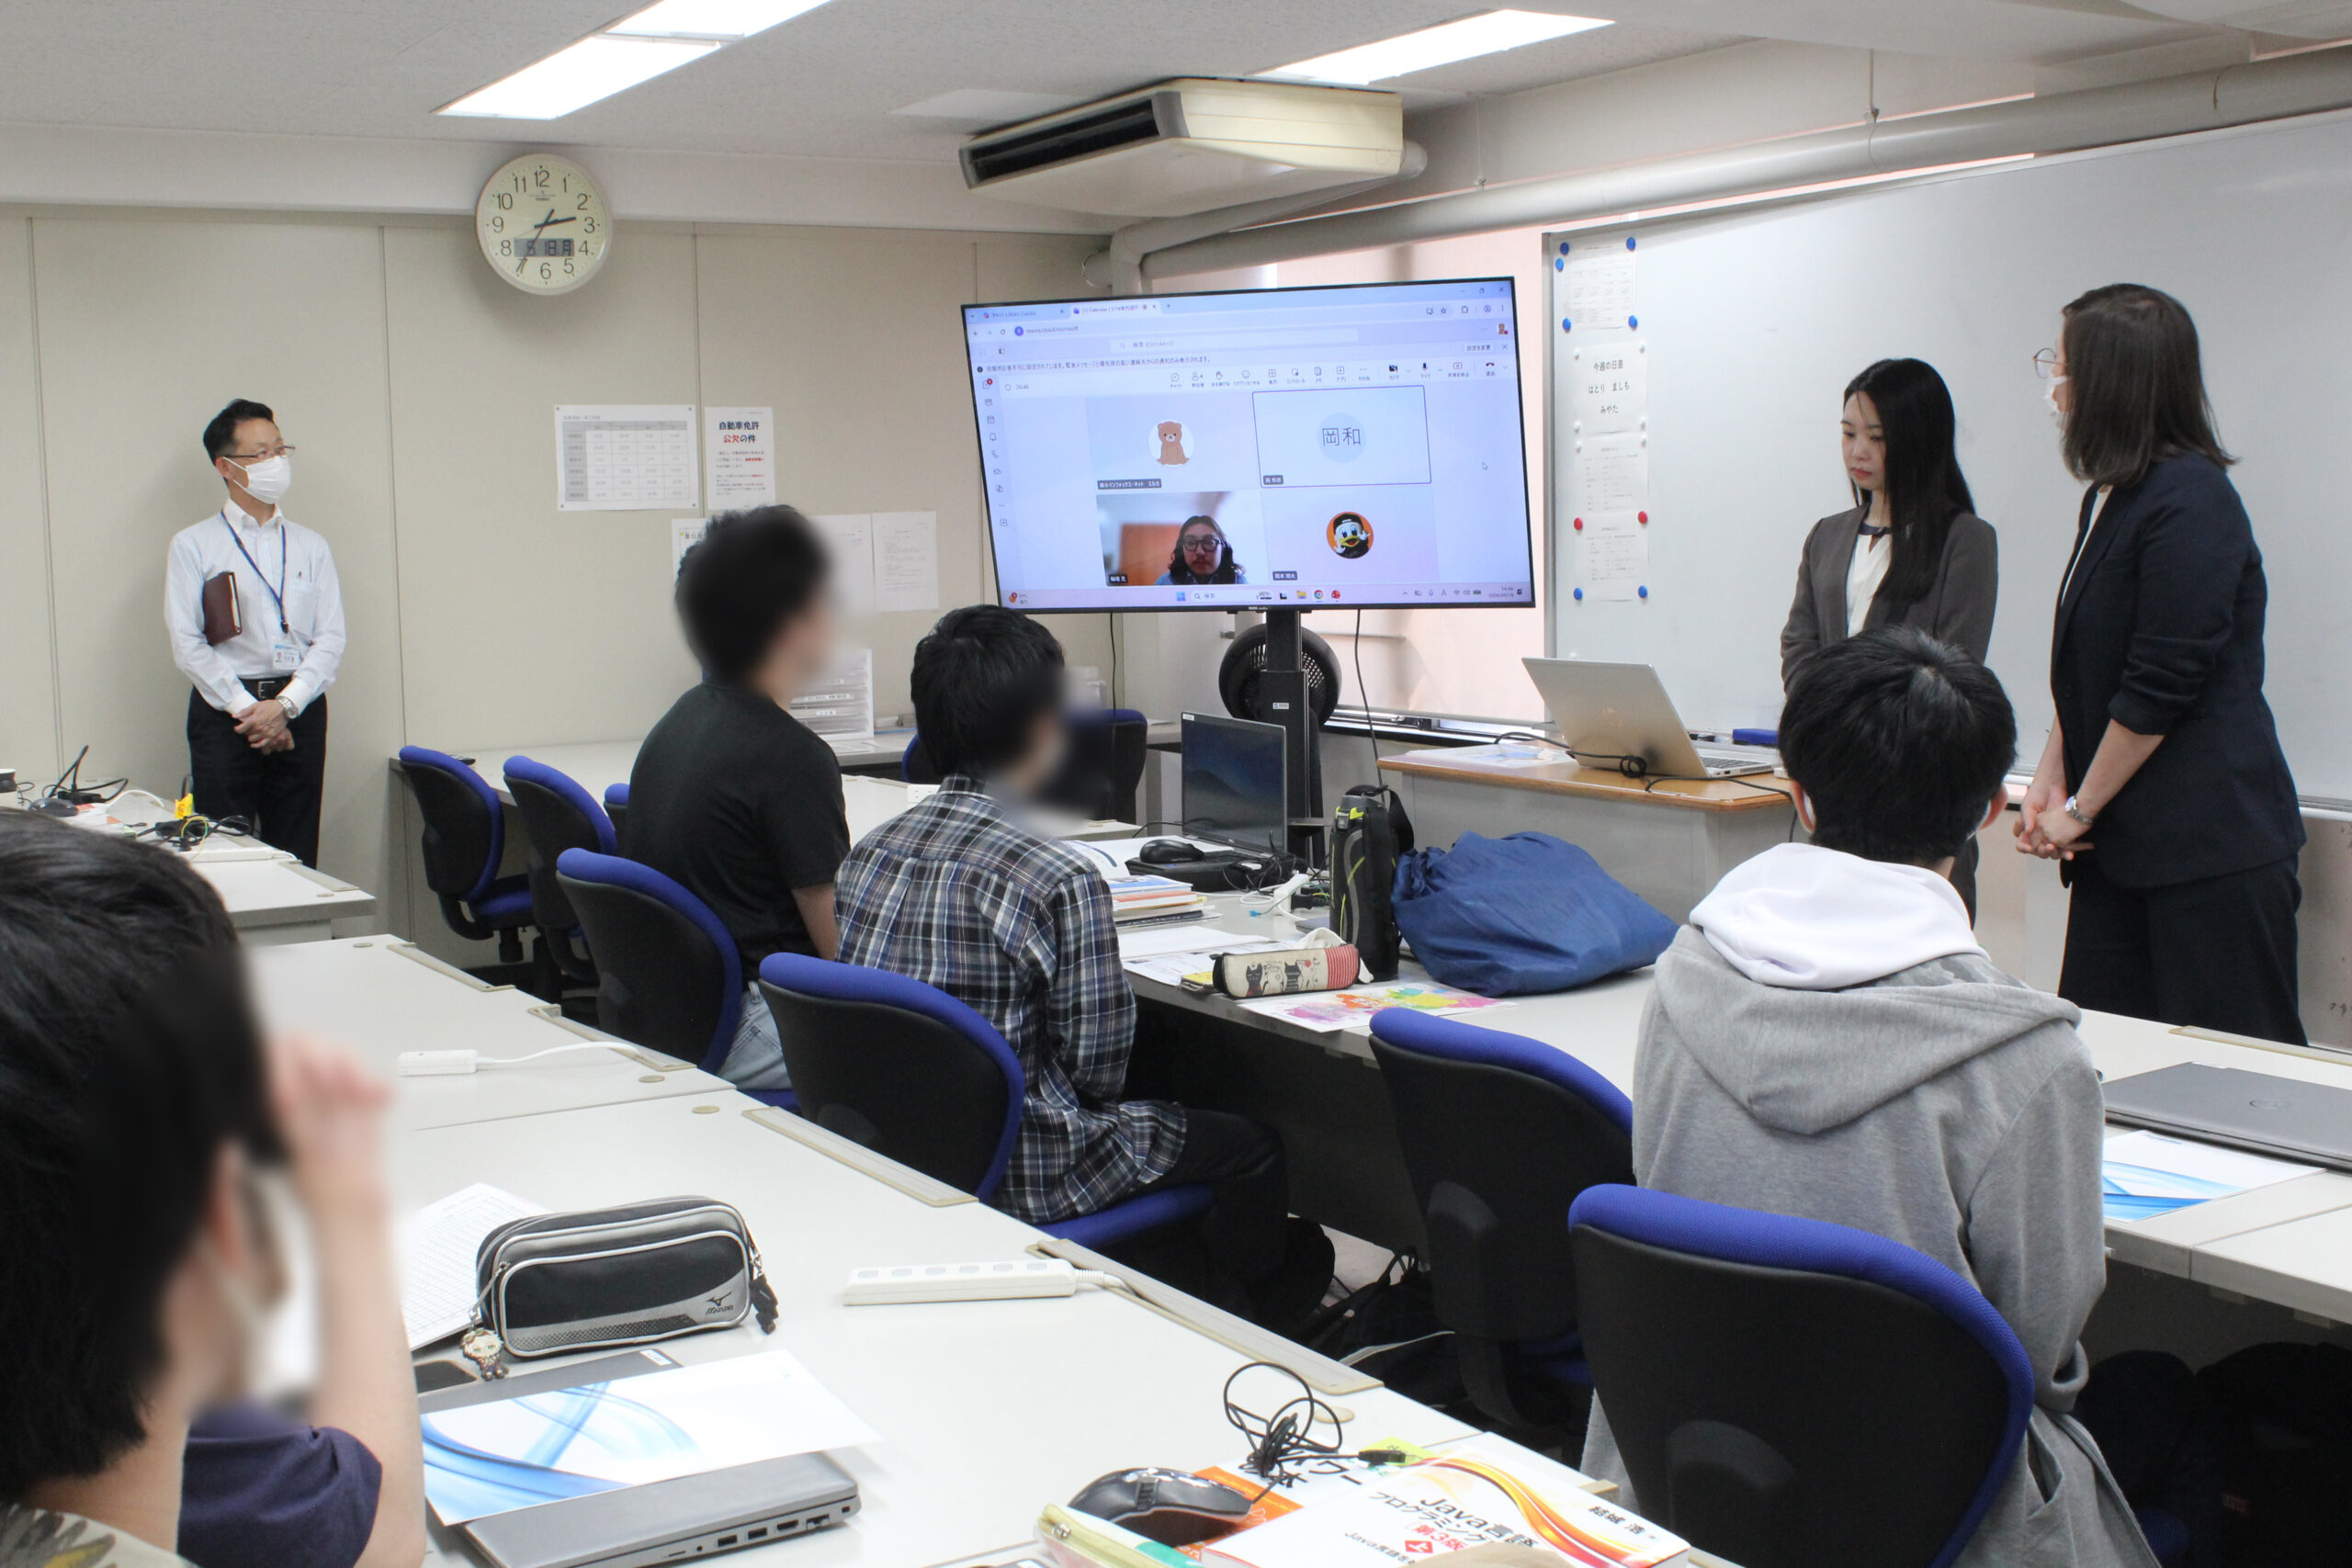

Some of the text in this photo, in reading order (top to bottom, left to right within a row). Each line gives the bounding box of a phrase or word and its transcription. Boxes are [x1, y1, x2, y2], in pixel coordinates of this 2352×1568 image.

[514, 176, 526, 193] 11
[534, 170, 549, 187] 12
[562, 176, 567, 193] 1
[497, 193, 513, 210] 10
[577, 193, 588, 210] 2
[492, 216, 503, 233] 9
[584, 217, 595, 233] 3
[501, 240, 512, 256] 8
[579, 241, 589, 256] 4
[516, 258, 527, 273] 7
[540, 263, 551, 279] 6
[563, 258, 574, 274] 5
[1593, 359, 1623, 372] 今週の日直
[1589, 380, 1630, 394] はとり ましも
[1600, 404, 1618, 414] みやた
[718, 421, 760, 430] 自動車免許
[723, 434, 756, 443] 公欠の件
[1322, 427, 1361, 446] 岡和
[1588, 1506, 1625, 1524] 結城
